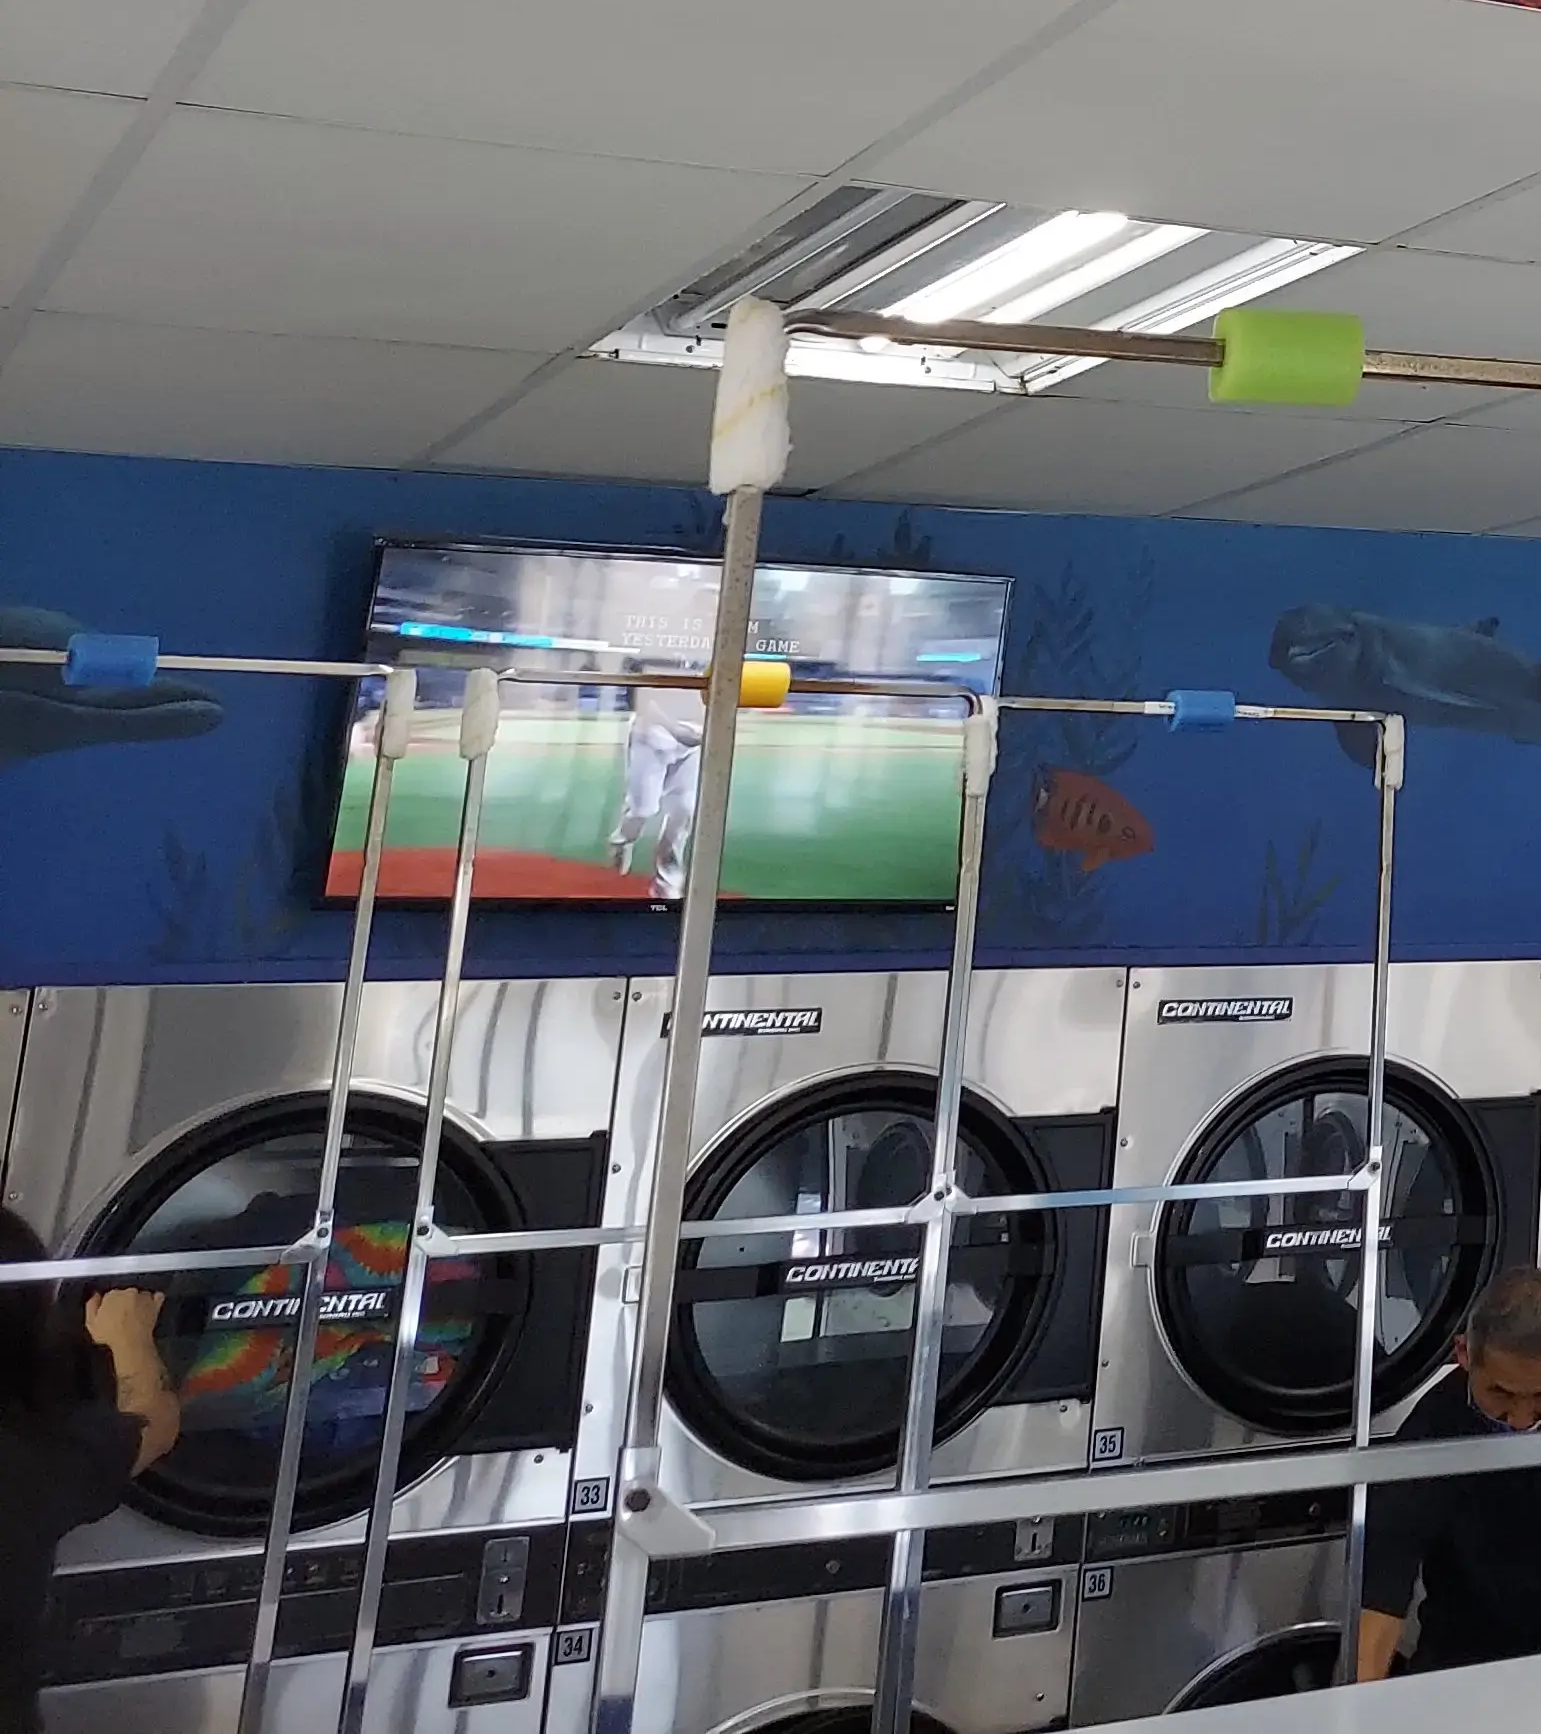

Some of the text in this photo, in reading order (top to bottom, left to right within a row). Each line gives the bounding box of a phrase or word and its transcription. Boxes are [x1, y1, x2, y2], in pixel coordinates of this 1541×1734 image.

[626, 615, 703, 629] THIS IS
[622, 632, 799, 653] YESTERDA GAME
[1162, 1000, 1290, 1017] CONTINENTAL
[702, 1011, 819, 1029] NTINENTAL
[1266, 1225, 1392, 1249] CONTINENAL
[785, 1257, 920, 1283] CONTINENT
[211, 1292, 386, 1321] CONTINTAL
[1099, 1434, 1117, 1454] 35
[580, 1484, 600, 1507] 33
[1088, 1573, 1106, 1594] 36
[563, 1635, 583, 1658] 34
